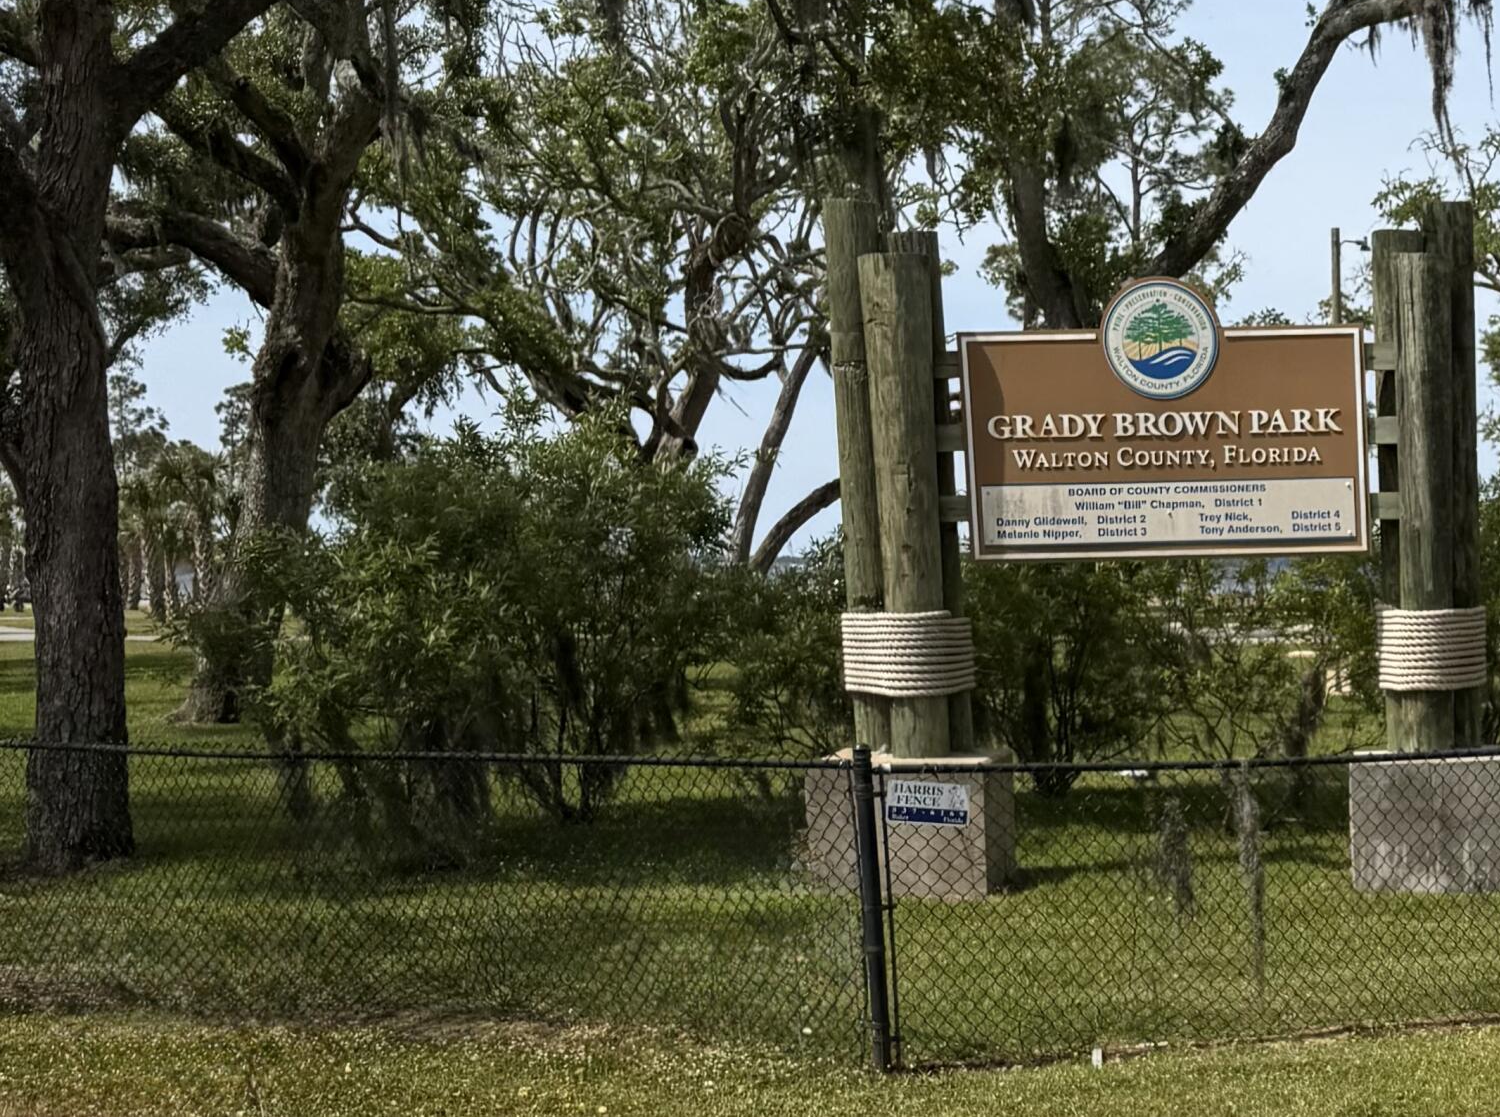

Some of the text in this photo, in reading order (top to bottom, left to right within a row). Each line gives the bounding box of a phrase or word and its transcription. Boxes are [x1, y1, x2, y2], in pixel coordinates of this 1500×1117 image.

[1113, 346, 1139, 382] WALTON
[1183, 346, 1209, 383] FLORIDA
[987, 408, 1343, 440] GRADY BROWN PARK
[1012, 445, 1322, 469] WALTON COUNTY, FLORIDA
[1068, 484, 1267, 497] BOARD OF COUNTY COMMISSIONERS
[1074, 500, 1115, 511] William
[1150, 499, 1205, 511] Chapman,
[1214, 498, 1254, 508] District
[1257, 498, 1263, 507] 1
[996, 514, 1147, 529] Danny Glidewell, District 2
[1224, 511, 1253, 522] Nick,
[1291, 510, 1331, 520] District
[1333, 510, 1341, 519] 4
[997, 527, 1148, 541] Melanie Nipper, District 3
[1200, 522, 1341, 536] Tony Anderson, District 5
[894, 783, 944, 796] HARRIS
[897, 795, 940, 807] FENCE
